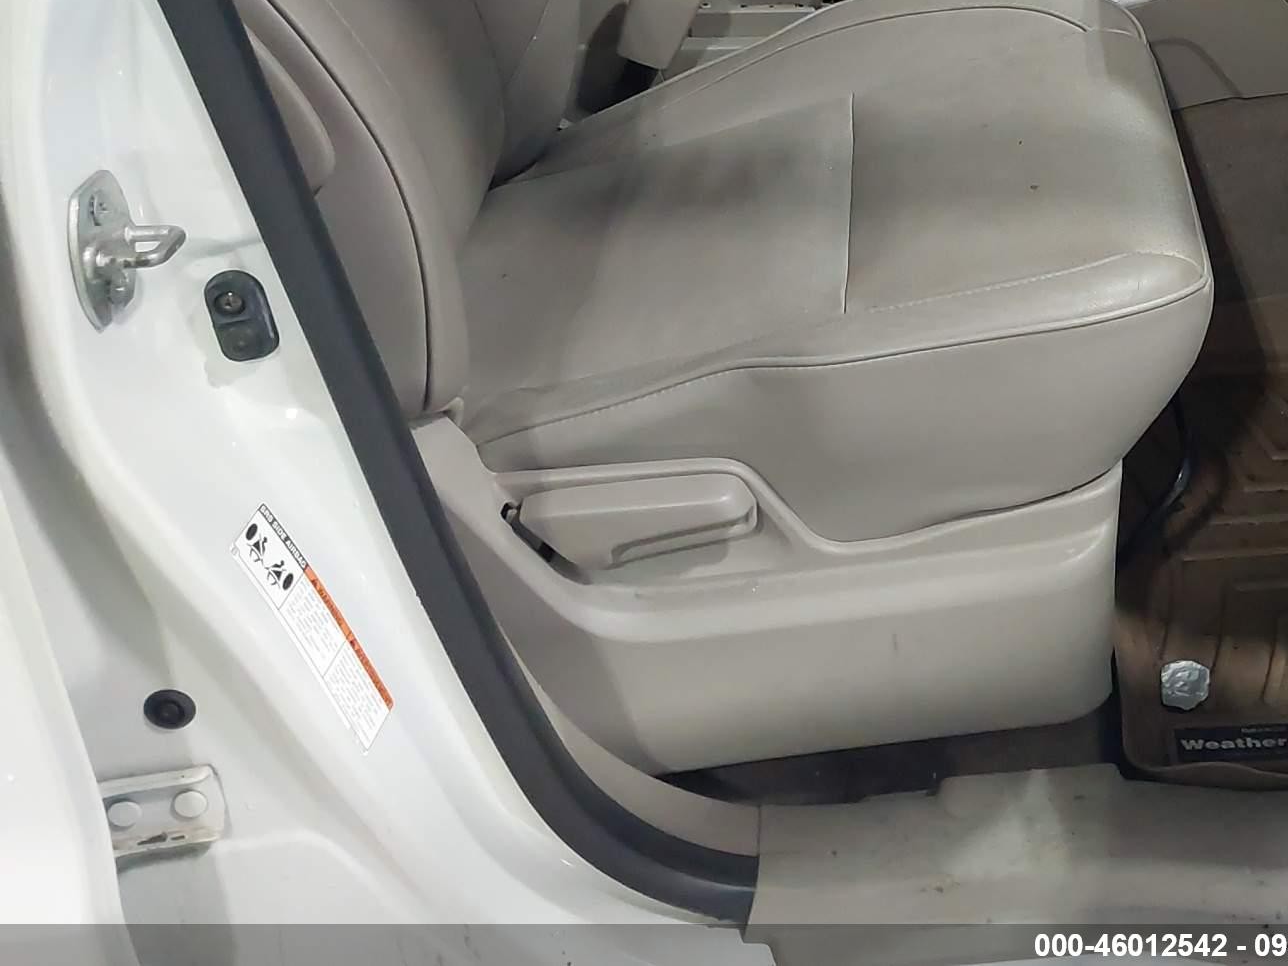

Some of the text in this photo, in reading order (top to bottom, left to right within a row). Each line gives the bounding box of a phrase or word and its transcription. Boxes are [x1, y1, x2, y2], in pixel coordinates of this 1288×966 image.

[271, 520, 288, 541] SIDE
[285, 538, 307, 569] AIRBAG
[1180, 737, 1287, 750] Weather
